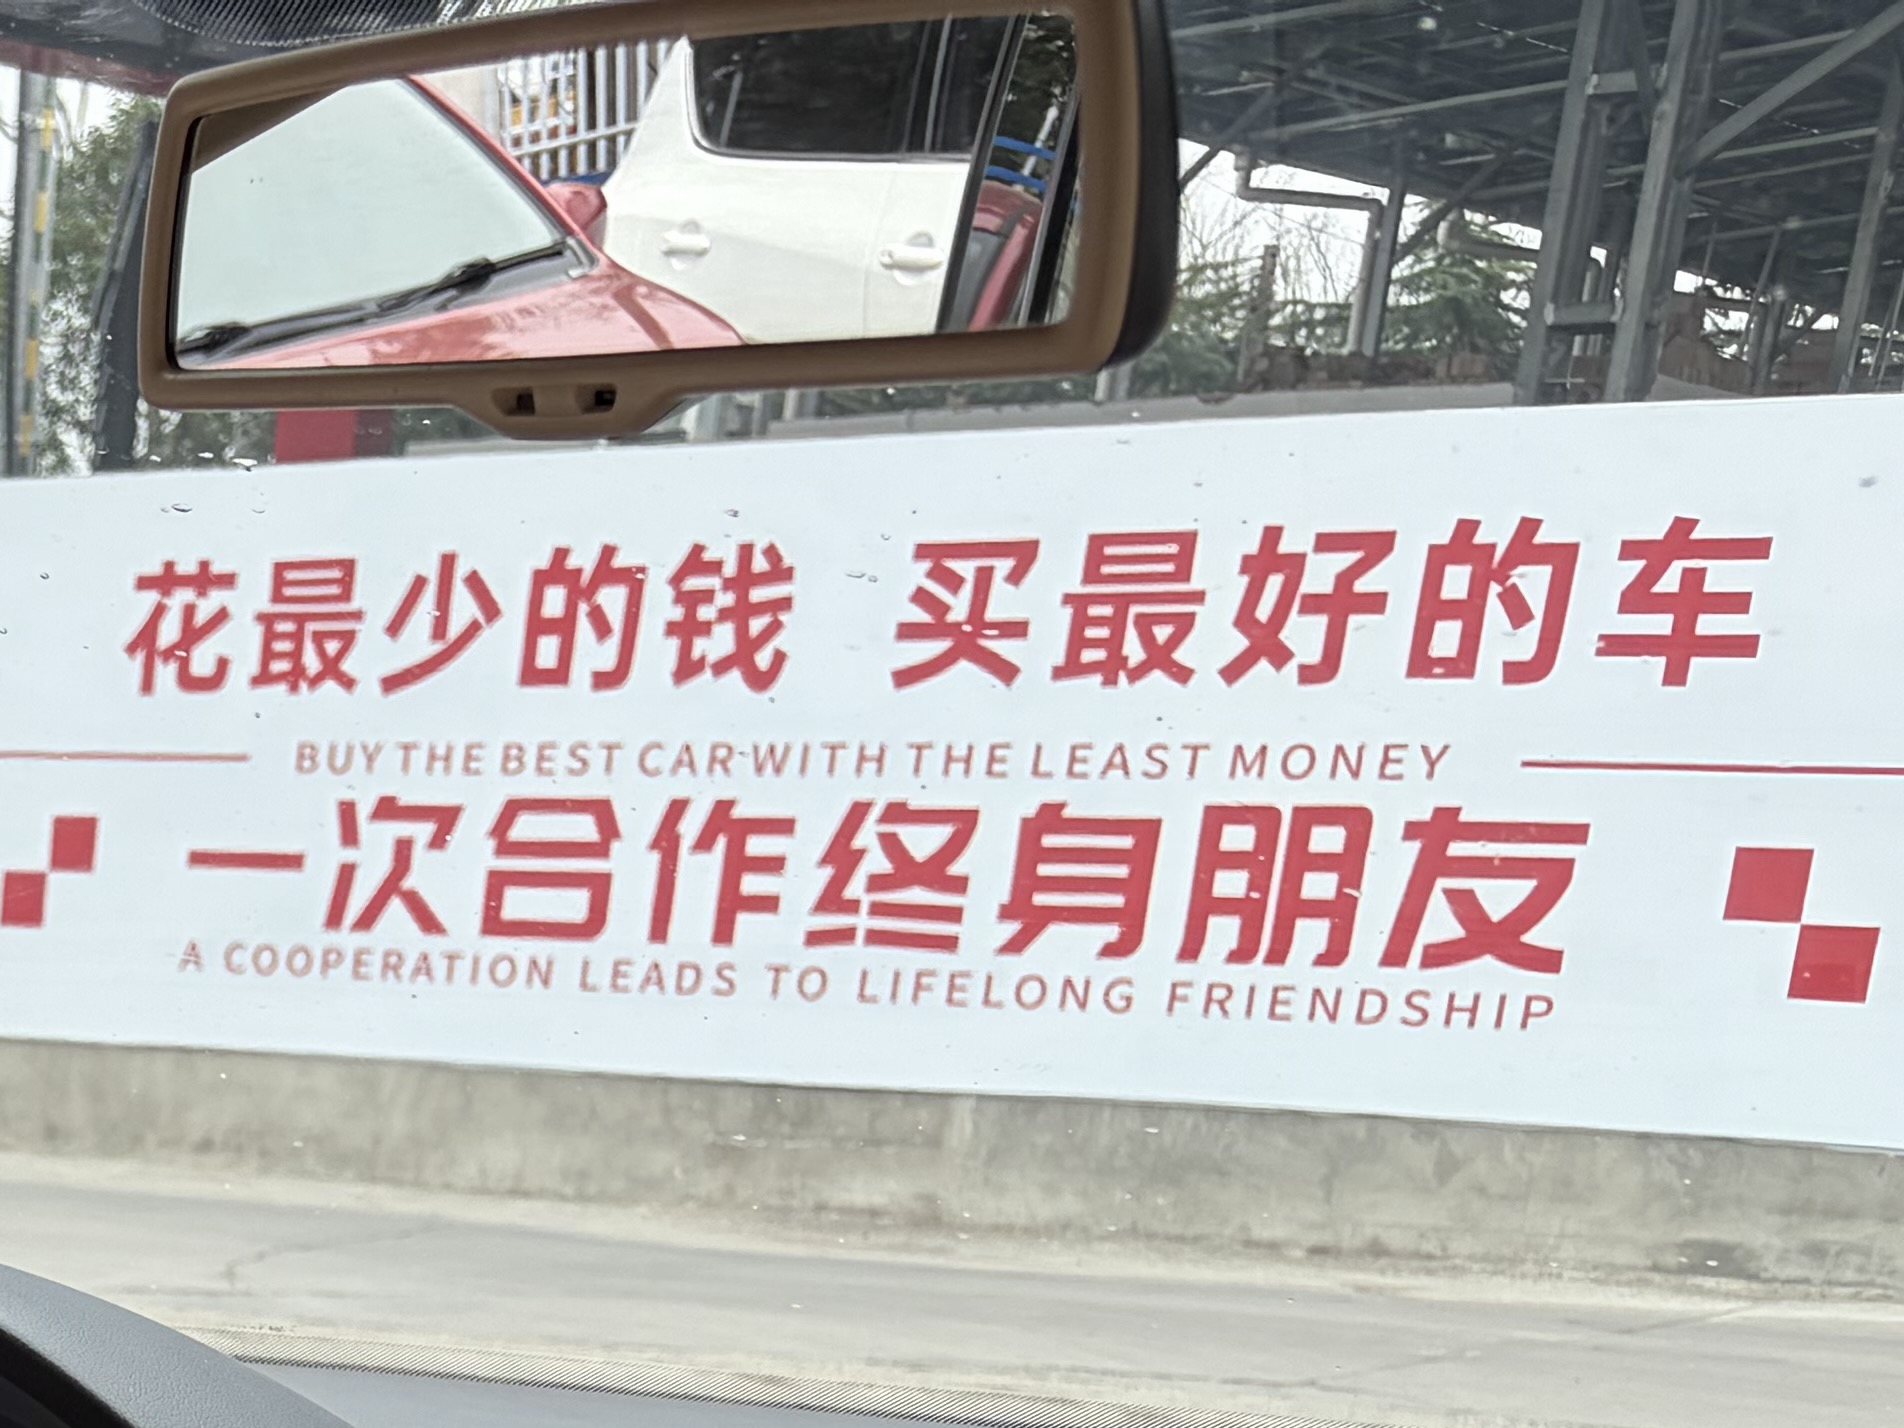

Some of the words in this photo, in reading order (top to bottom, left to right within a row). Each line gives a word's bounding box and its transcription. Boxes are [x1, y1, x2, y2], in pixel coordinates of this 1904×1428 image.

[123, 541, 795, 696] 花最少的钱
[891, 515, 1773, 690] 买最好的车
[295, 741, 381, 776] BUY
[400, 743, 481, 775] THE
[502, 743, 619, 775] BEST
[640, 743, 735, 776] CAR
[754, 743, 886, 775] WITH
[911, 743, 1007, 777] THE
[1032, 743, 1207, 779] LEAST
[1229, 743, 1448, 781] MONEY
[187, 795, 1590, 976] 一次合作终身朋友
[179, 941, 205, 973] A
[225, 941, 555, 991] COOPERATION
[580, 960, 735, 995] LEADS
[768, 964, 827, 999] TO
[858, 971, 1133, 1013] LIFELONG
[1166, 978, 1557, 1032] FRIENDSHIP
